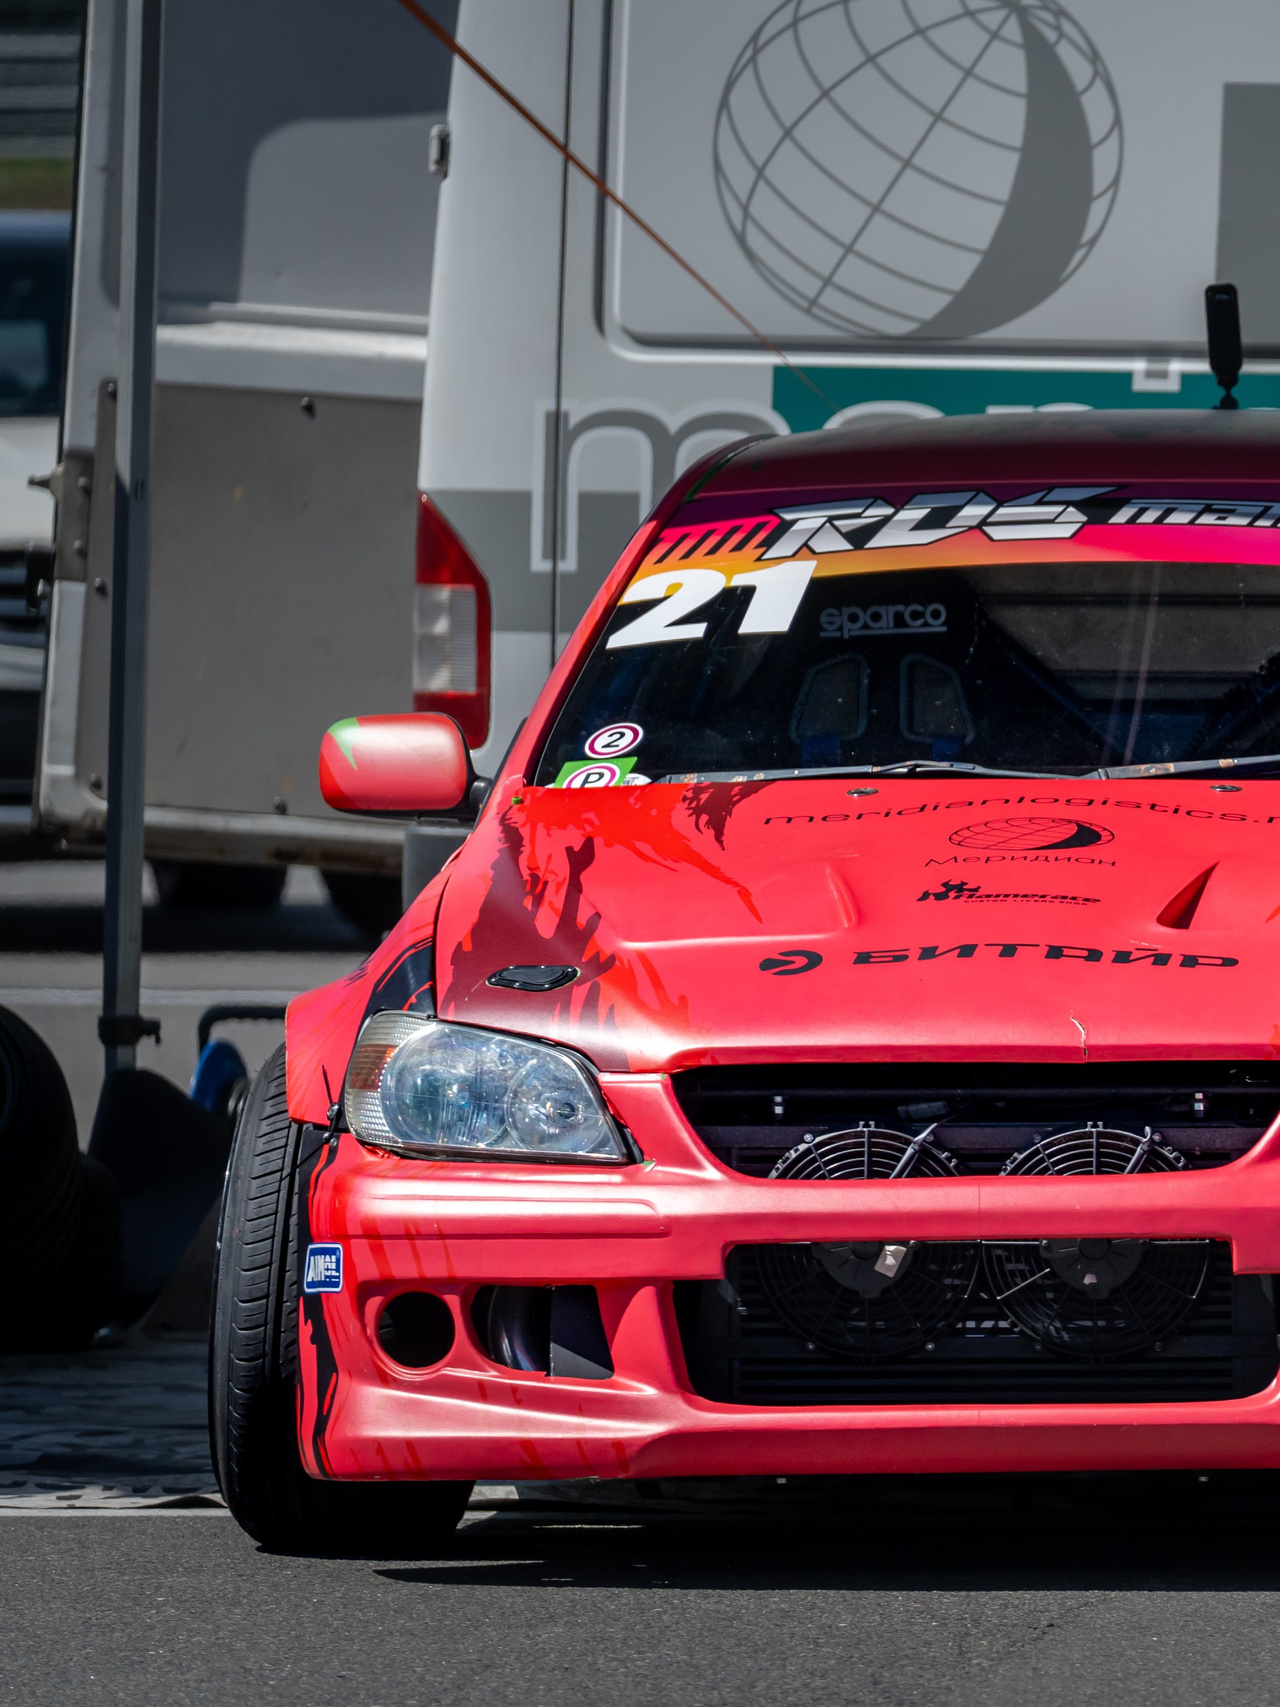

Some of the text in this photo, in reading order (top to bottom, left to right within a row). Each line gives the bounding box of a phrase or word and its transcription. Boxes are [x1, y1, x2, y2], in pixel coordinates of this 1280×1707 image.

[756, 486, 1126, 560] RDS
[605, 560, 818, 650] 21
[820, 603, 948, 639] sparco
[601, 731, 626, 749] 2
[580, 771, 605, 788] P
[924, 854, 1117, 868] Меридиан
[307, 1254, 340, 1282] AIMOL
